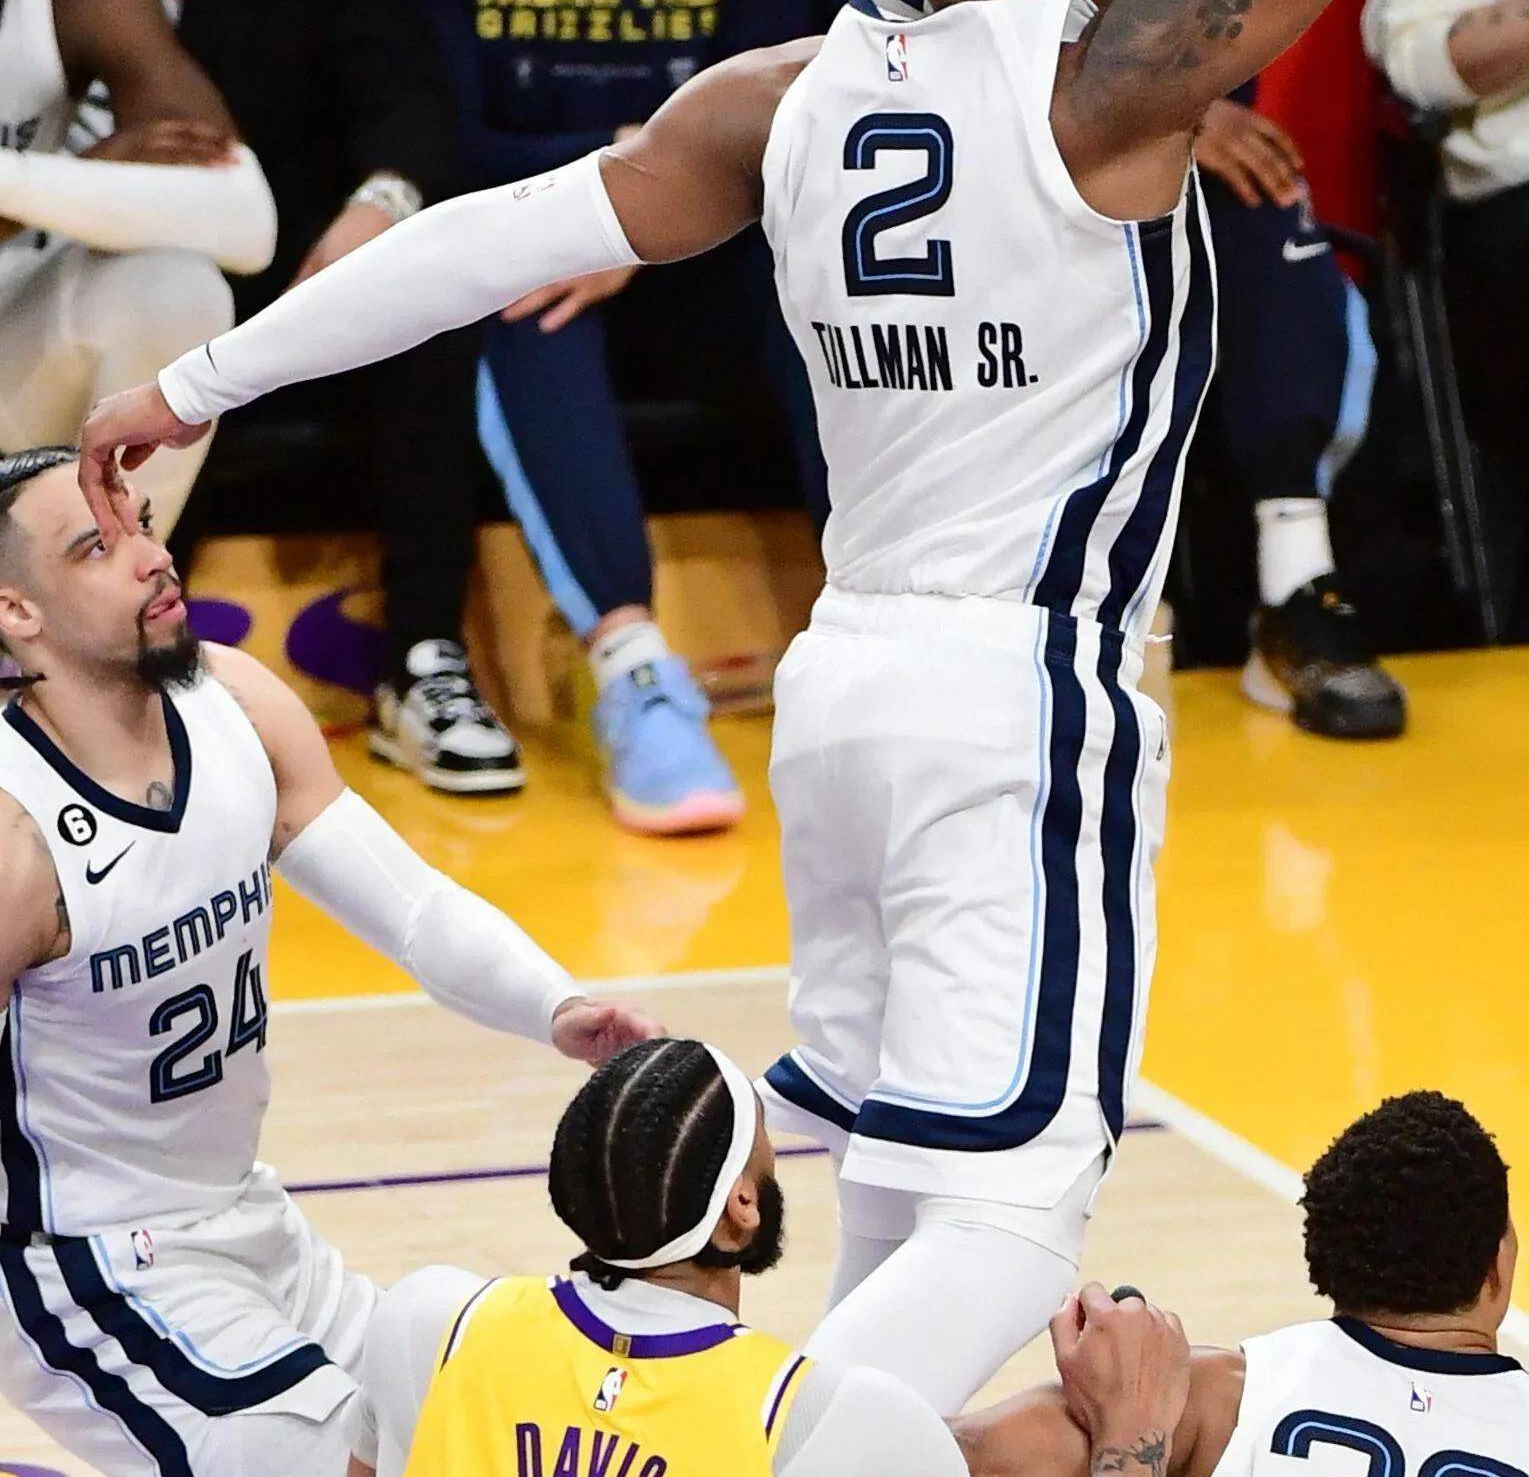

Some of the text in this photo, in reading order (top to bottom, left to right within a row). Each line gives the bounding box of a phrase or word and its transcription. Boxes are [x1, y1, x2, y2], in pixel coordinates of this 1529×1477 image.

[842, 112, 954, 298] 2
[811, 321, 1039, 390] TILLMAN SR.
[62, 806, 93, 843] 6
[89, 860, 273, 993] MEMPHI
[150, 949, 268, 1104] 24
